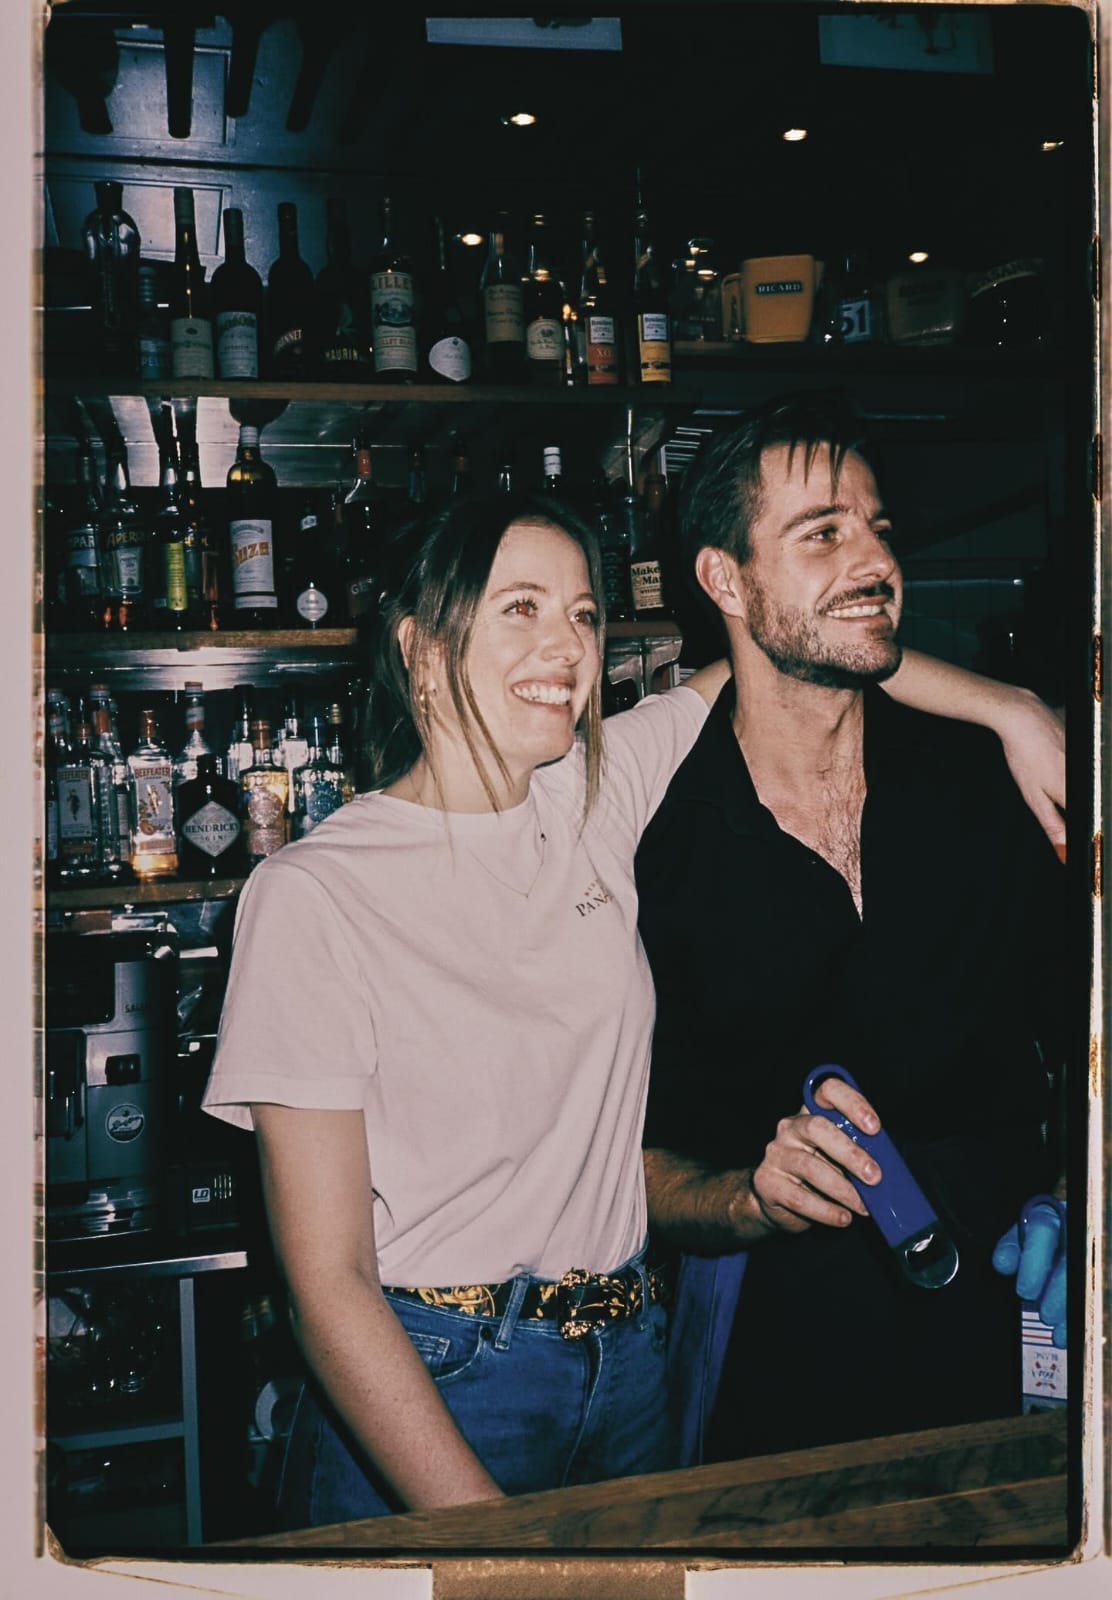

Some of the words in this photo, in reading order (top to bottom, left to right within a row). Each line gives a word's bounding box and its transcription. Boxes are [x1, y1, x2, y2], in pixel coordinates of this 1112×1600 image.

[758, 282, 802, 294] RICARD
[841, 302, 868, 336] 51
[72, 535, 96, 548] PAR
[106, 531, 145, 548] APER
[135, 767, 171, 779] BEEFEATER
